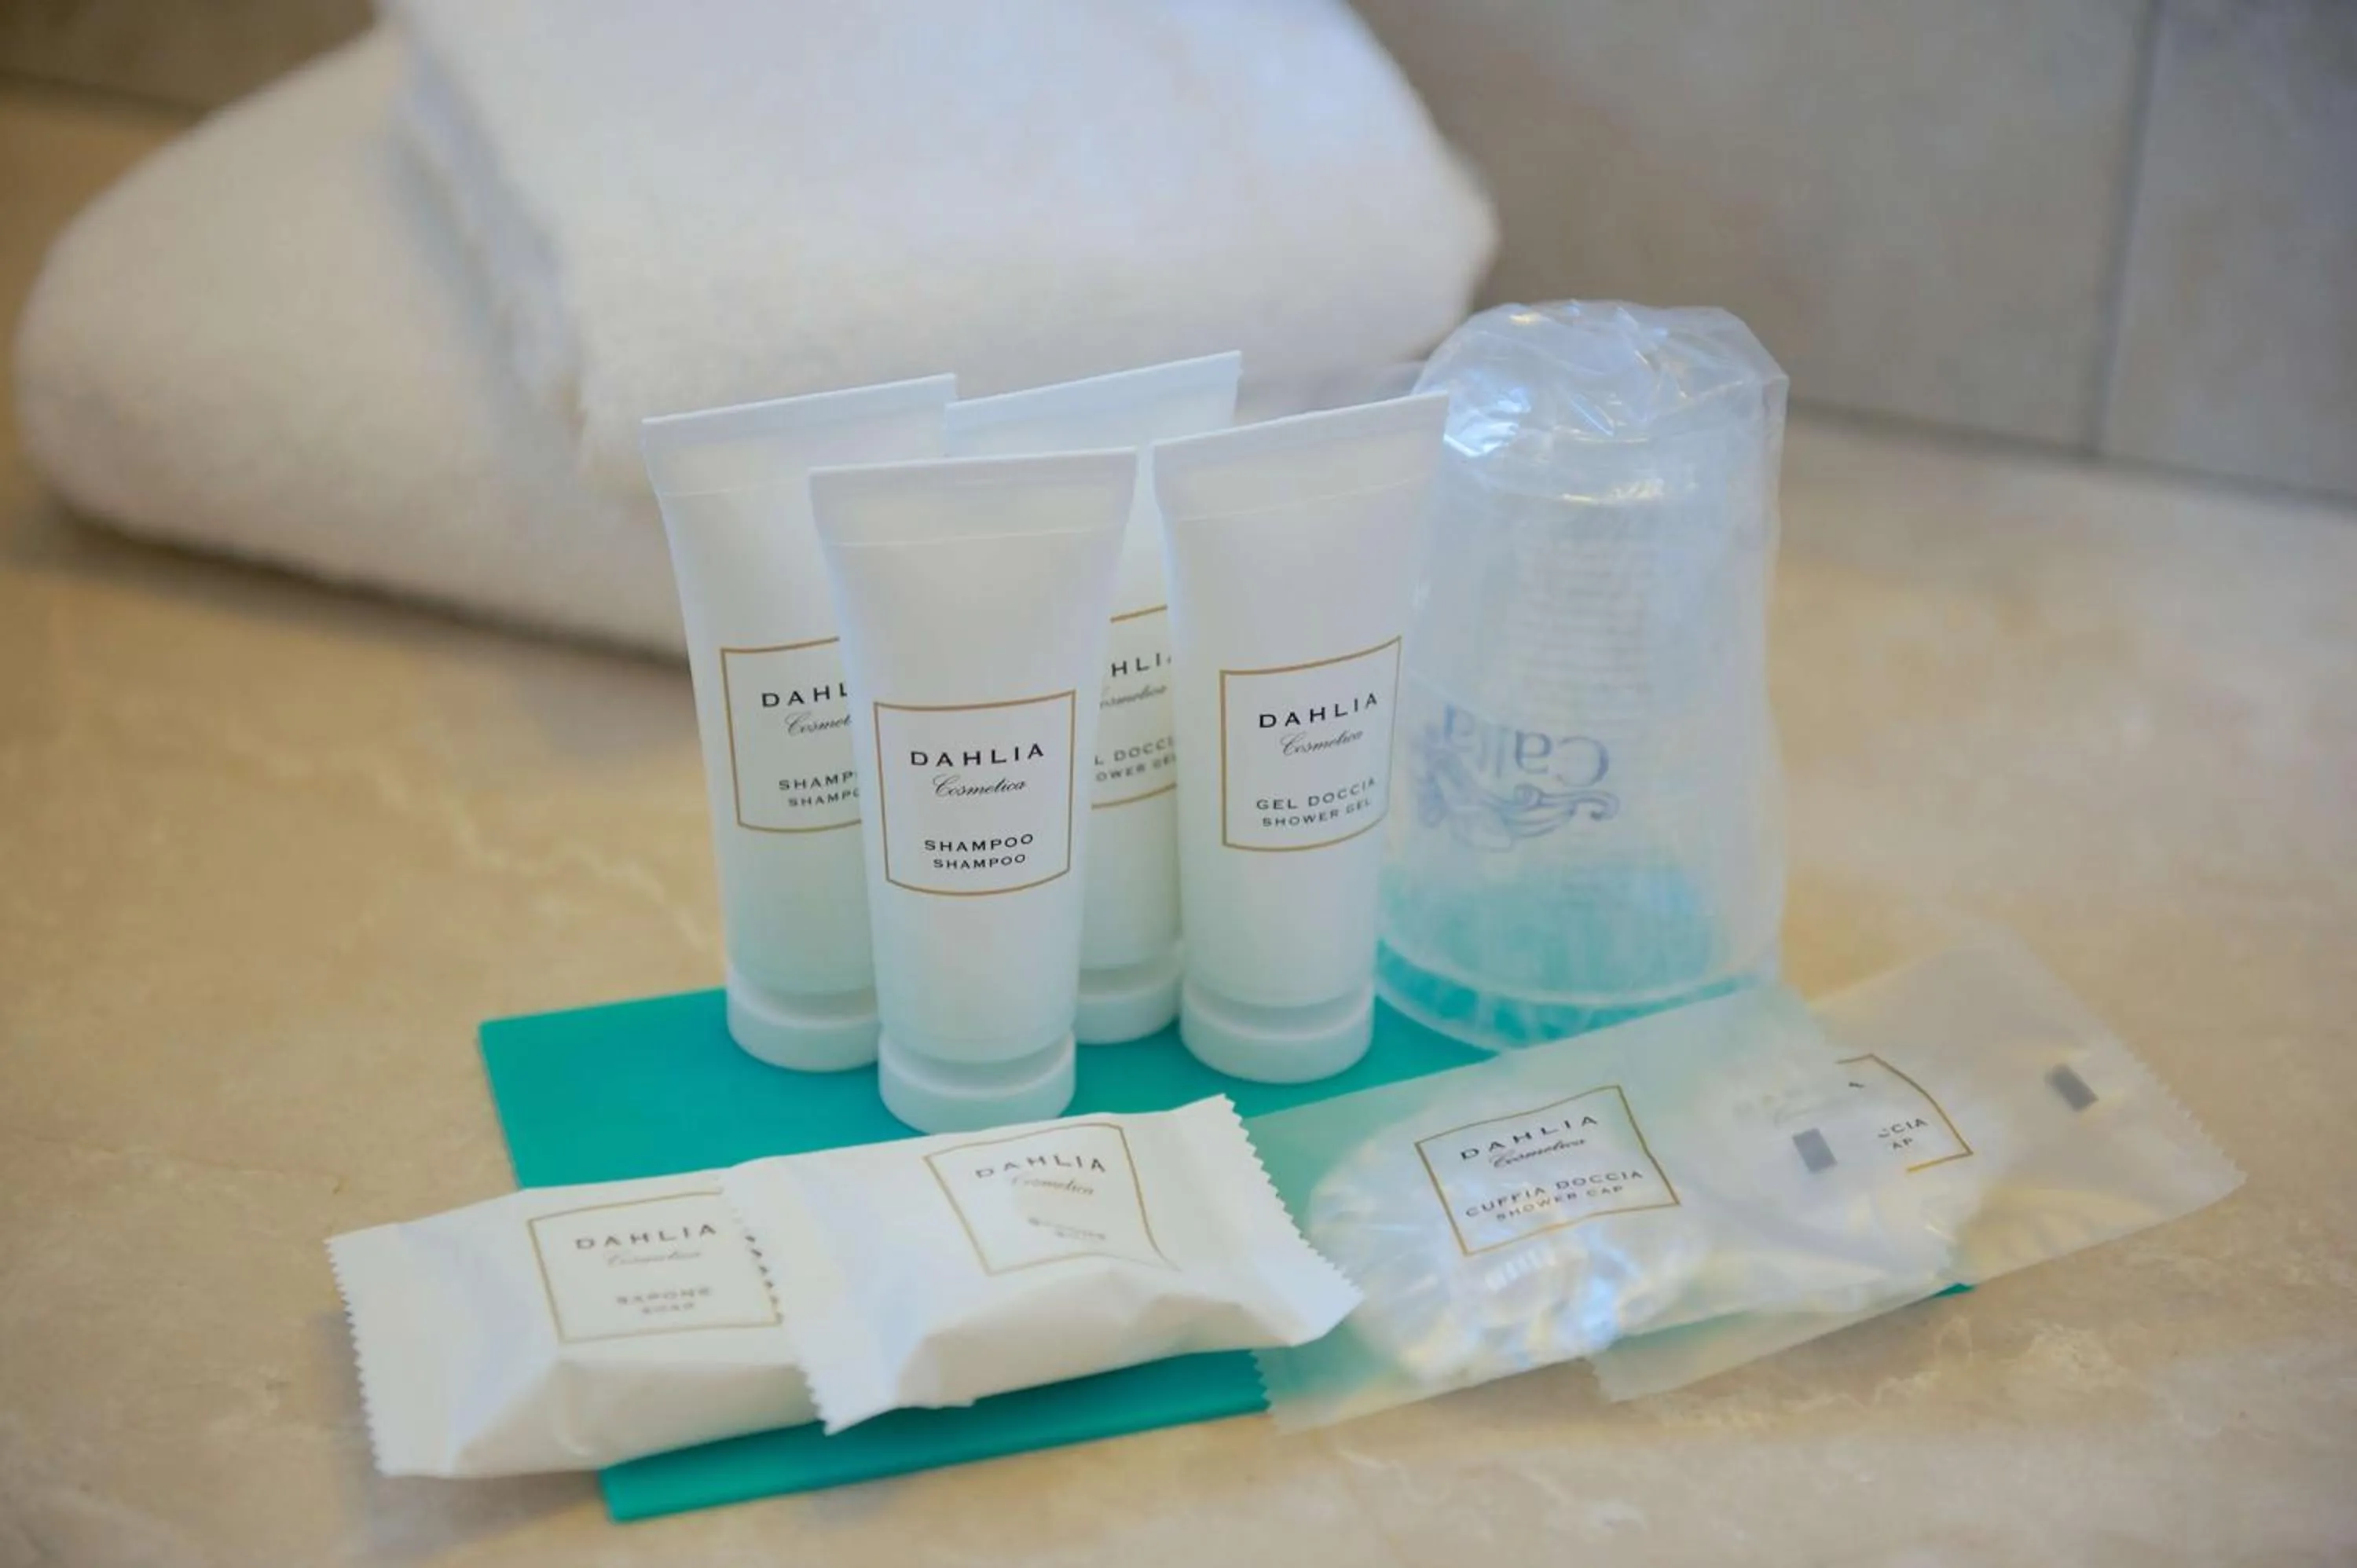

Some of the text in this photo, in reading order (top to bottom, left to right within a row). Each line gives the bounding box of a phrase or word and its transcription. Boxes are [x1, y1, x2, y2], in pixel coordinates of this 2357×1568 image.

[1111, 652, 1171, 677] HLI
[1259, 692, 1377, 728] DAHLIA
[911, 742, 1043, 767] DAHLIA
[1280, 728, 1363, 756] Cosmetica
[933, 773, 1027, 797] Cosmetica
[1256, 777, 1376, 811] GEL DOCCIA
[1263, 797, 1371, 827] SHOWER GEL
[925, 833, 1033, 852] SHAMPOO
[933, 854, 1026, 869] SHAMPOO
[1461, 1116, 1597, 1160] DAHLIA
[976, 1153, 1106, 1178] DAHLIA
[1466, 1170, 1643, 1217] CUFFIA DOCCIA
[1497, 1192, 1578, 1221] SHOWER
[575, 1224, 717, 1250] DAHLIA
